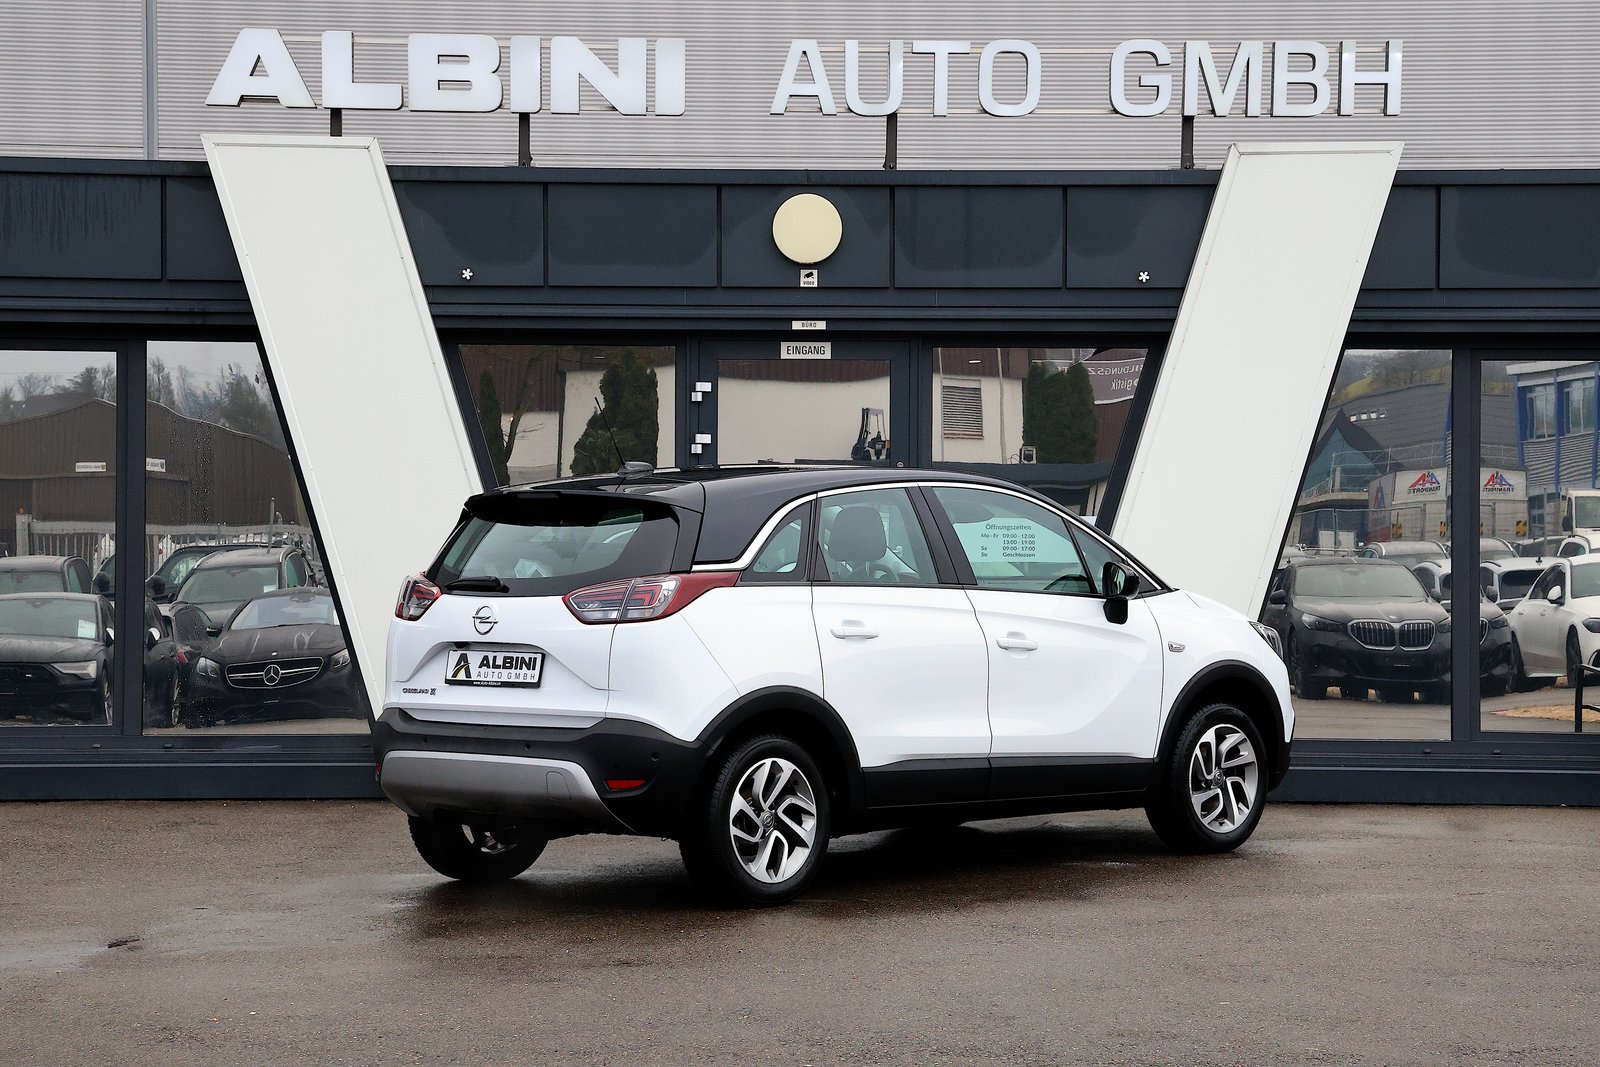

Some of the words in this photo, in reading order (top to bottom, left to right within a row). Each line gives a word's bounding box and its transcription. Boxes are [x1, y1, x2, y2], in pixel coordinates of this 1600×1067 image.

[205, 27, 686, 116] ALBINI
[769, 38, 1042, 118] AUTO
[1108, 38, 1404, 118] GMBH
[786, 345, 826, 356] EINGANG
[985, 523, 1032, 531] Öffnungszeiten
[478, 654, 538, 671] ALBINI
[476, 670, 502, 679] AUTO
[506, 672, 536, 681] GMBH
